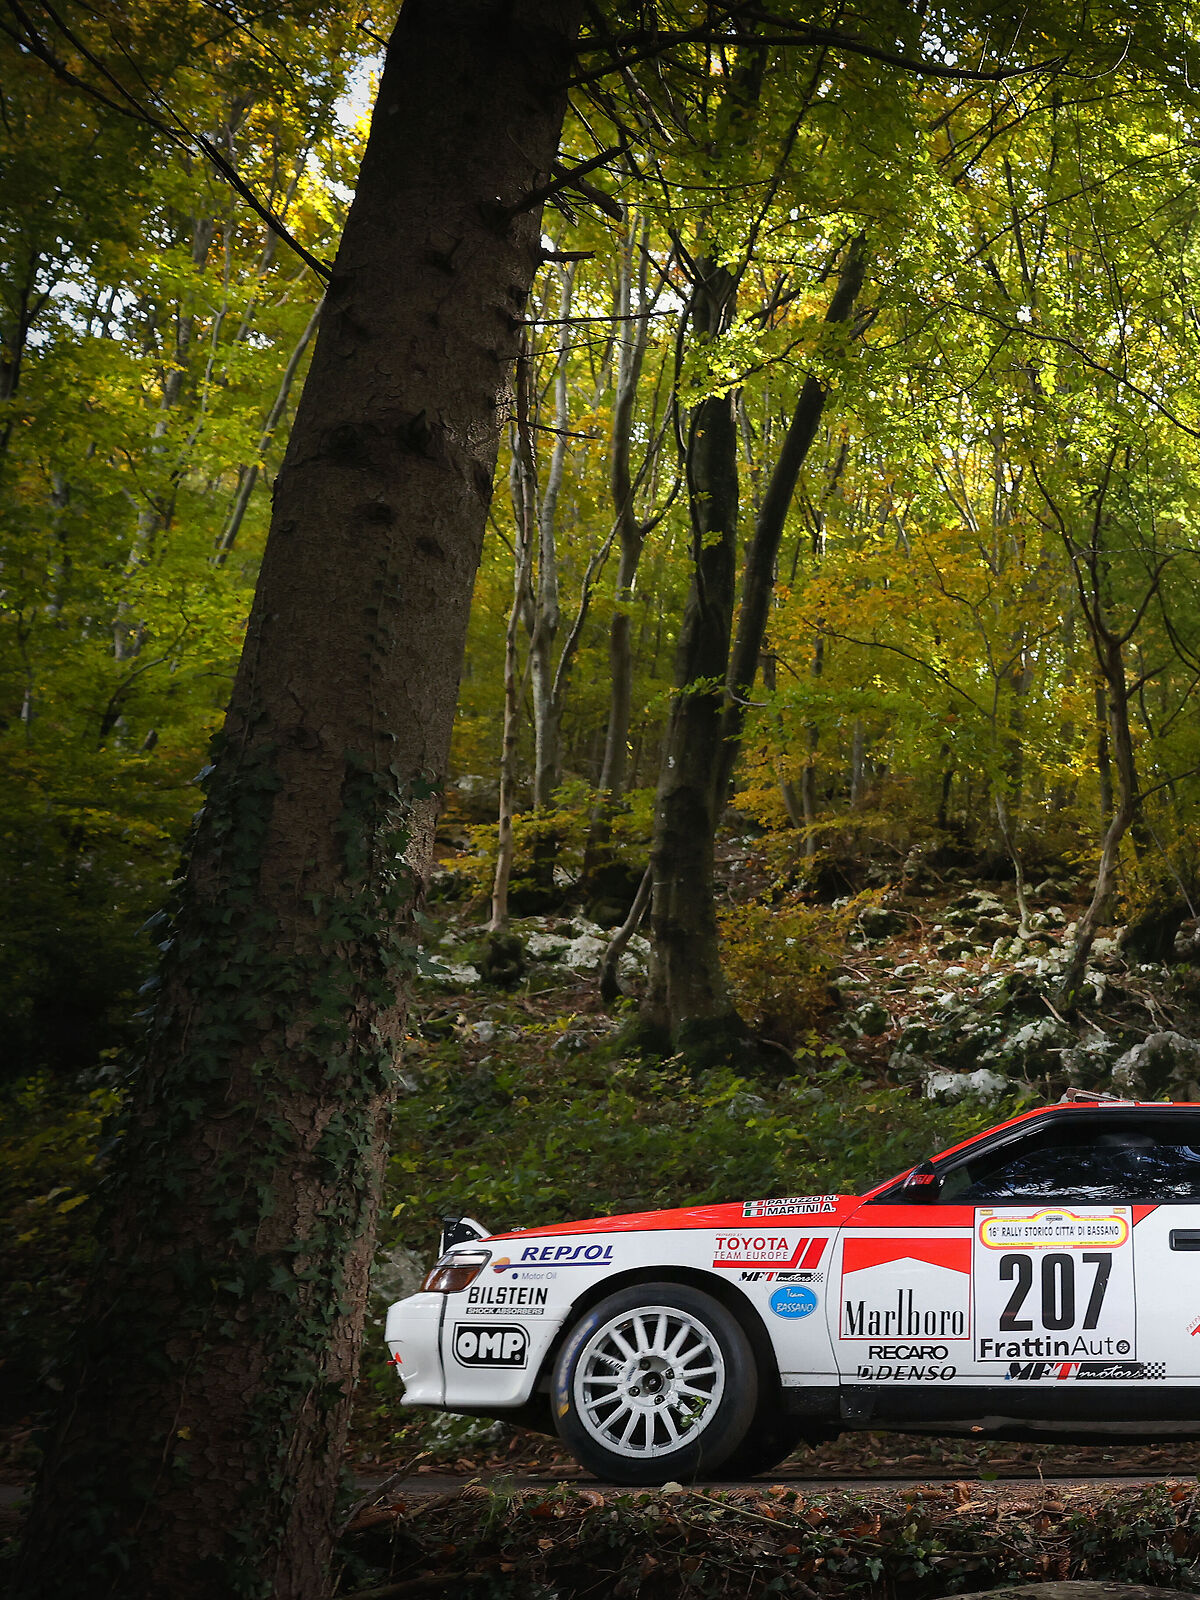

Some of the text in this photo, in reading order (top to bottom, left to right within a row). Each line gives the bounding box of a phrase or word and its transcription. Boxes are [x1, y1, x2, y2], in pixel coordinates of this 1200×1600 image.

[767, 1196, 821, 1206] PATUZZO
[767, 1203, 836, 1215] MARTINI A.
[1002, 1227, 1022, 1237] RALLY
[1024, 1226, 1053, 1237] STORICO
[1078, 1226, 1085, 1236] DI
[1087, 1226, 1119, 1236] BASSANO
[715, 1237, 789, 1251] TOYOTA
[521, 1244, 614, 1261] REPSOL
[713, 1251, 788, 1260] TEAM EUROPE
[521, 1271, 557, 1280] Motor Oil
[741, 1271, 779, 1282] MFT
[467, 1286, 549, 1305] BILSTEIN
[786, 1288, 805, 1298] Team
[999, 1252, 1113, 1331] 207
[495, 1307, 543, 1315] ABSORBERS
[776, 1302, 814, 1313] BASSANO
[843, 1288, 964, 1336] Marlboro
[457, 1331, 525, 1359] OMP
[868, 1344, 949, 1360] RECARO
[1008, 1362, 1144, 1380] MFT motors
